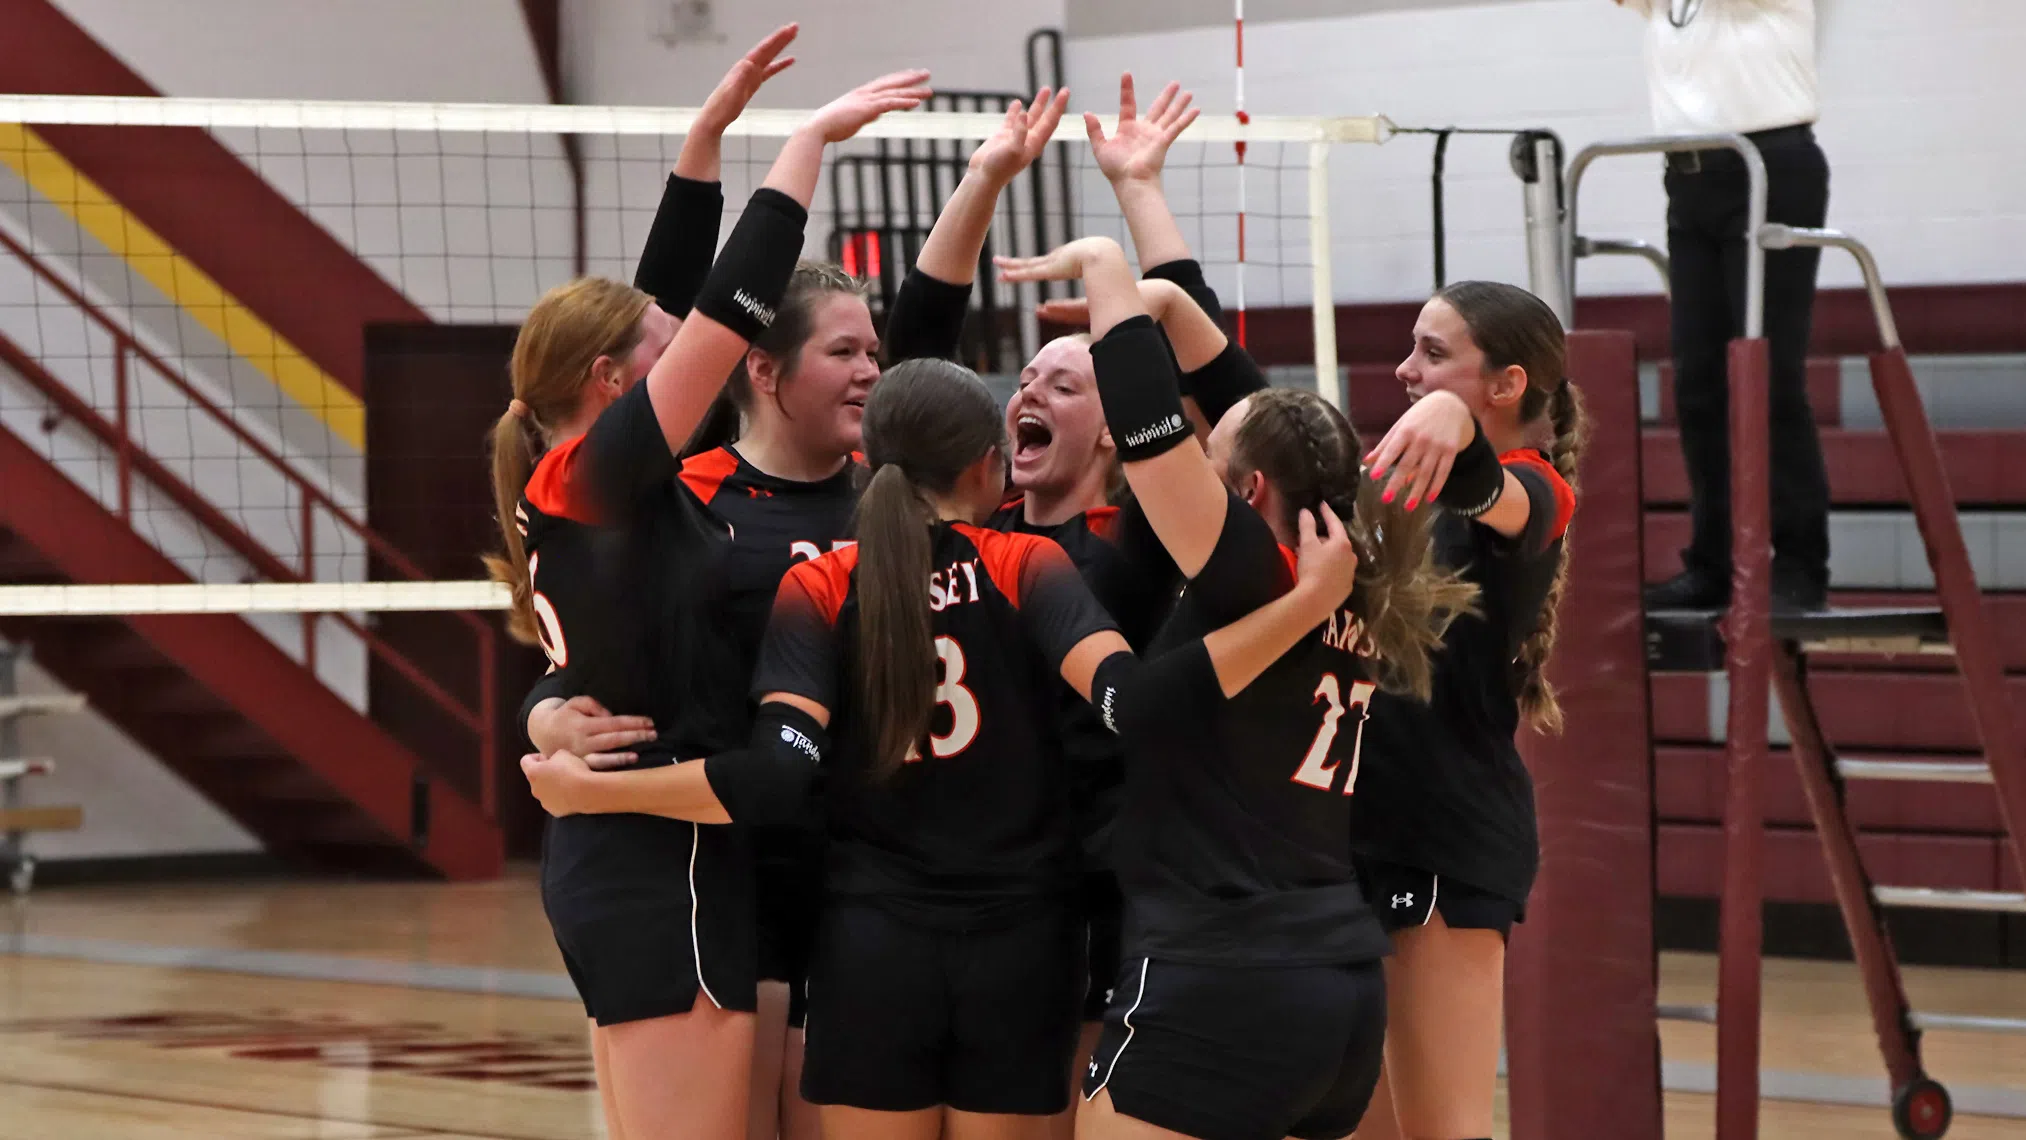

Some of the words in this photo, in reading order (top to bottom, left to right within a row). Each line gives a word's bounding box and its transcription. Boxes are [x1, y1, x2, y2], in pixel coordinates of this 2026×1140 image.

[1126, 416, 1184, 447] Tandem
[929, 557, 979, 612] SEY
[782, 725, 821, 762] Tande
[1290, 671, 1377, 796] 27
